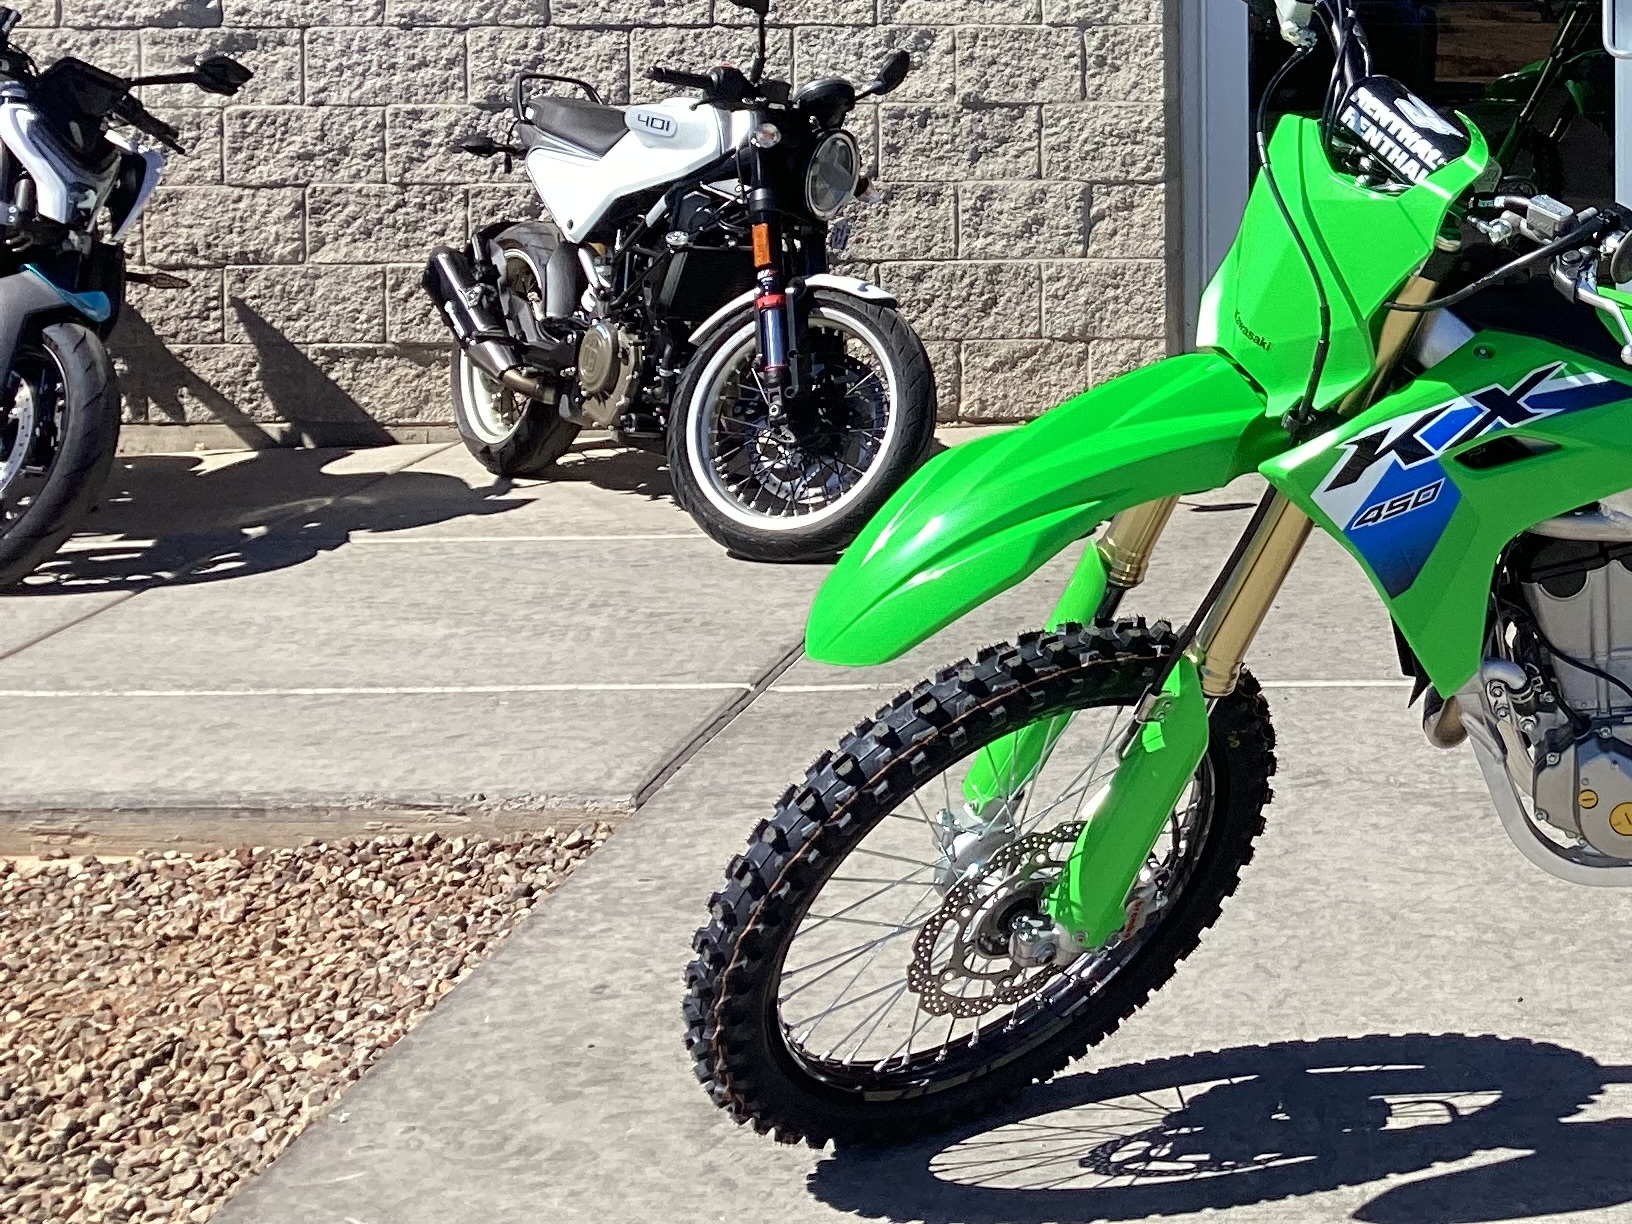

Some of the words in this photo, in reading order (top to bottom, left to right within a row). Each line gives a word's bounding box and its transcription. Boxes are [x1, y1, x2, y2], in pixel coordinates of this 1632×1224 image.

[637, 113, 671, 132] 401
[1323, 360, 1566, 493] KX
[1351, 478, 1446, 530] 450
